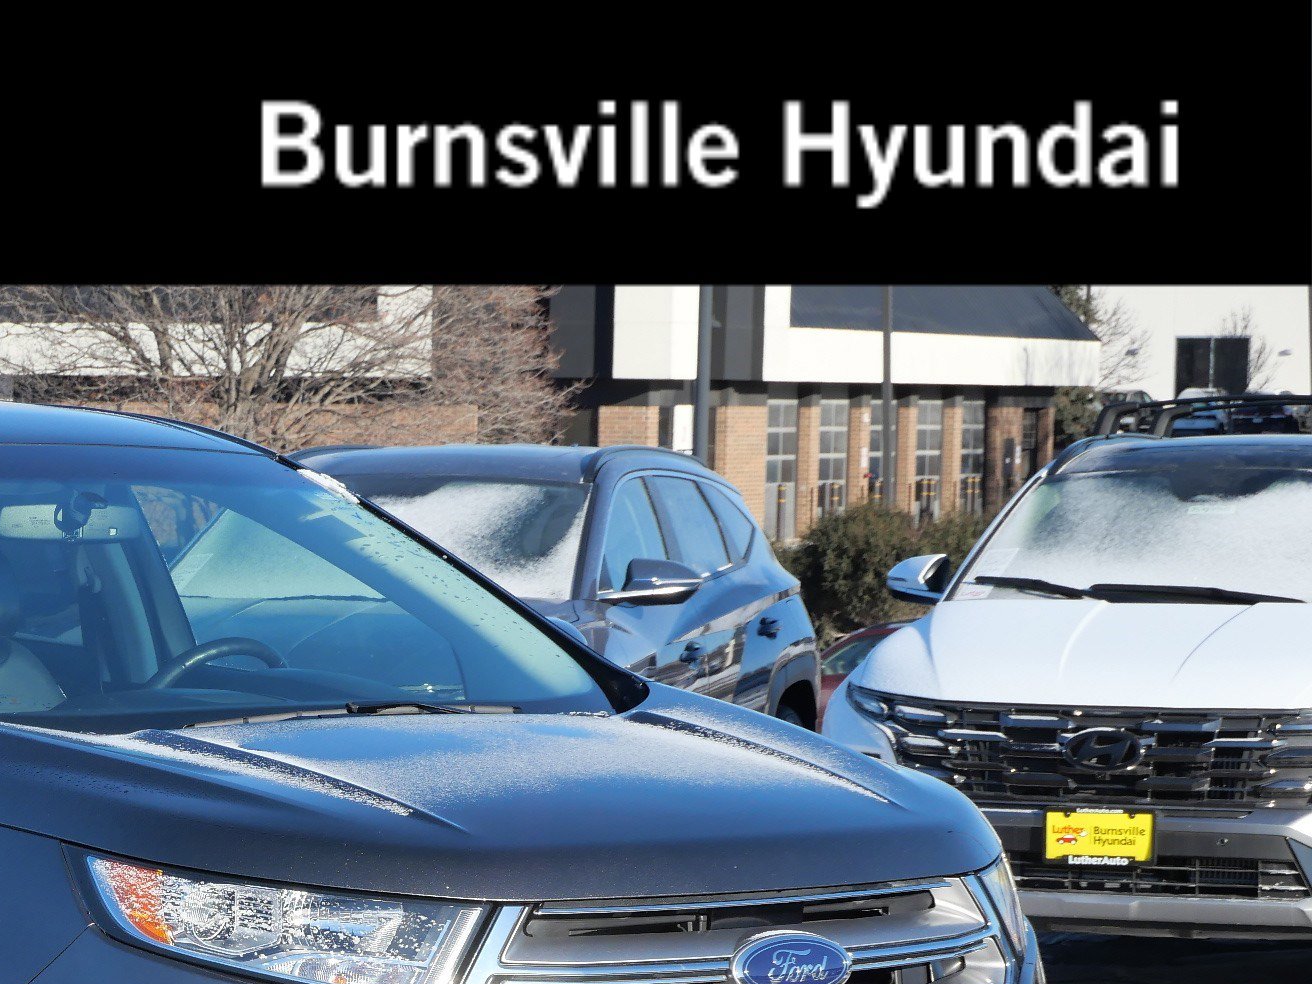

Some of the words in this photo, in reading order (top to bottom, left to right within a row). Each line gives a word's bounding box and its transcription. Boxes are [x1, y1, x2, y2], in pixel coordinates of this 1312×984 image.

[1052, 825, 1085, 834] Luther
[1093, 826, 1146, 836] Burnsville
[1093, 836, 1137, 847] Hyundai
[1068, 855, 1129, 866] LutherAuto
[768, 948, 829, 984] Ford
